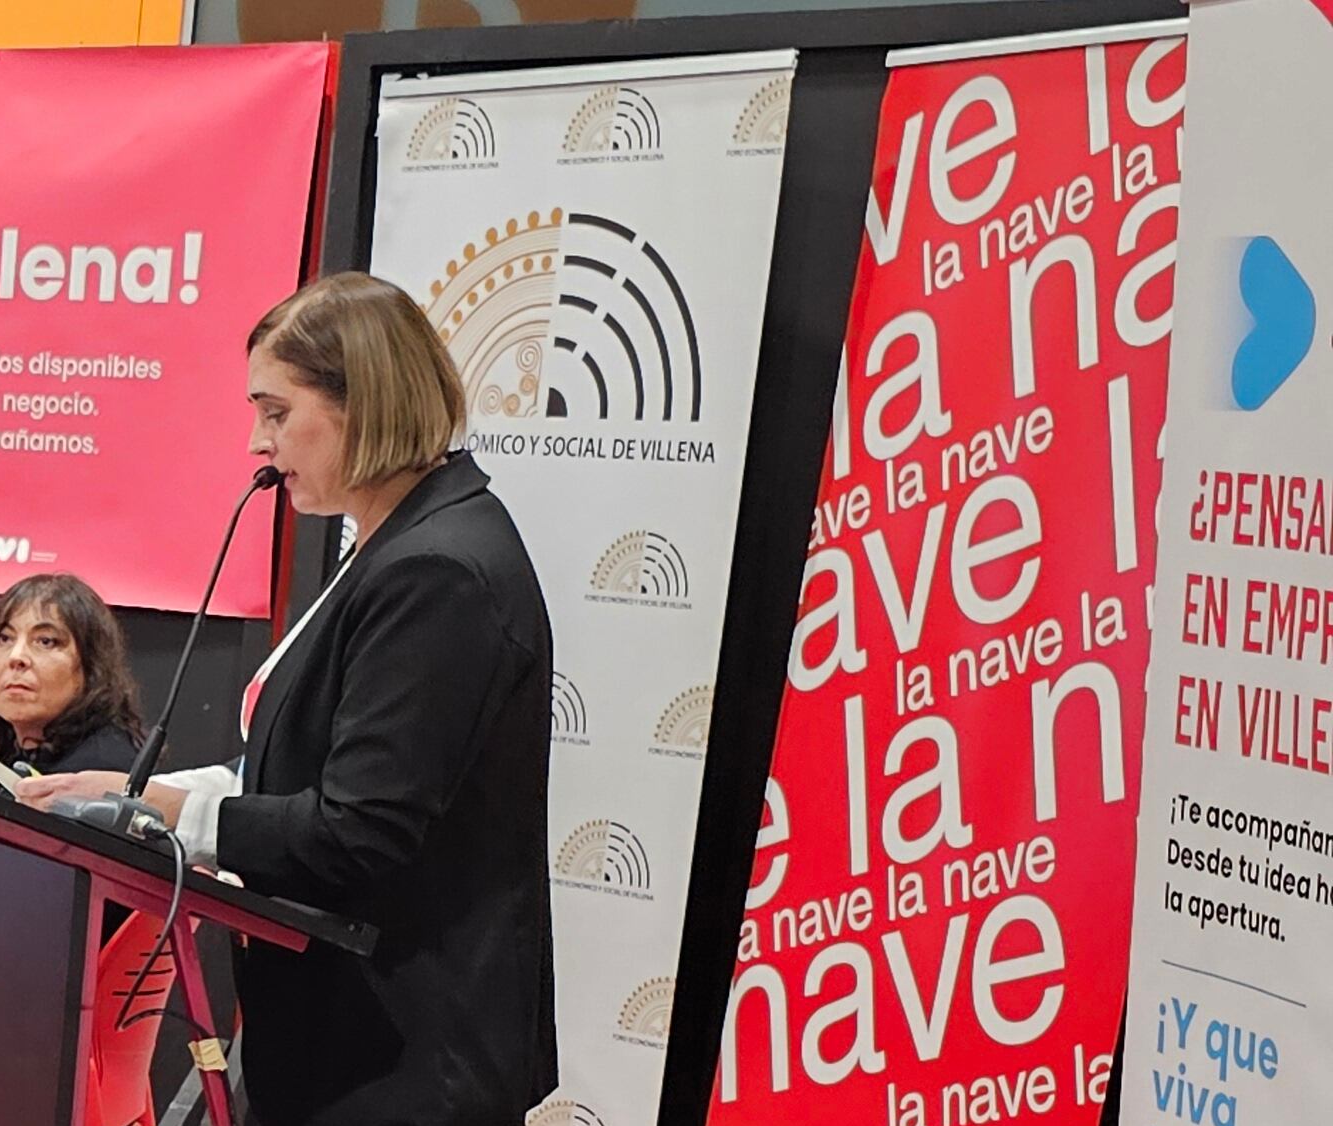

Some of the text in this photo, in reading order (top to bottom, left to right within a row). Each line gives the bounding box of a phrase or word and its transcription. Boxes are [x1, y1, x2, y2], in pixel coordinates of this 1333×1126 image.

[923, 239, 964, 296] la
[979, 175, 1094, 269] nave
[1112, 142, 1158, 202] la
[3, 392, 99, 420] negocio.
[28, 351, 162, 382] disponibles
[464, 428, 715, 464] ÓMICO Y SOCIAL DE VILLENA
[885, 458, 927, 514] la
[941, 406, 1054, 491] nave
[1189, 470, 1333, 556] ¿PENSA
[1182, 573, 1228, 648] EN
[895, 591, 1127, 716] la nave la
[1175, 675, 1222, 751] EN
[844, 694, 973, 877] la
[1171, 794, 1202, 825] ¡Te
[773, 887, 873, 952] nave
[888, 864, 927, 922] la
[943, 835, 1056, 907] nave
[1167, 838, 1233, 879] Desde
[1239, 855, 1260, 886] tu
[1264, 857, 1311, 900] idea
[1164, 881, 1285, 942] la apertura.
[720, 894, 1066, 1104] nave
[1156, 997, 1278, 1082] ¡Y que
